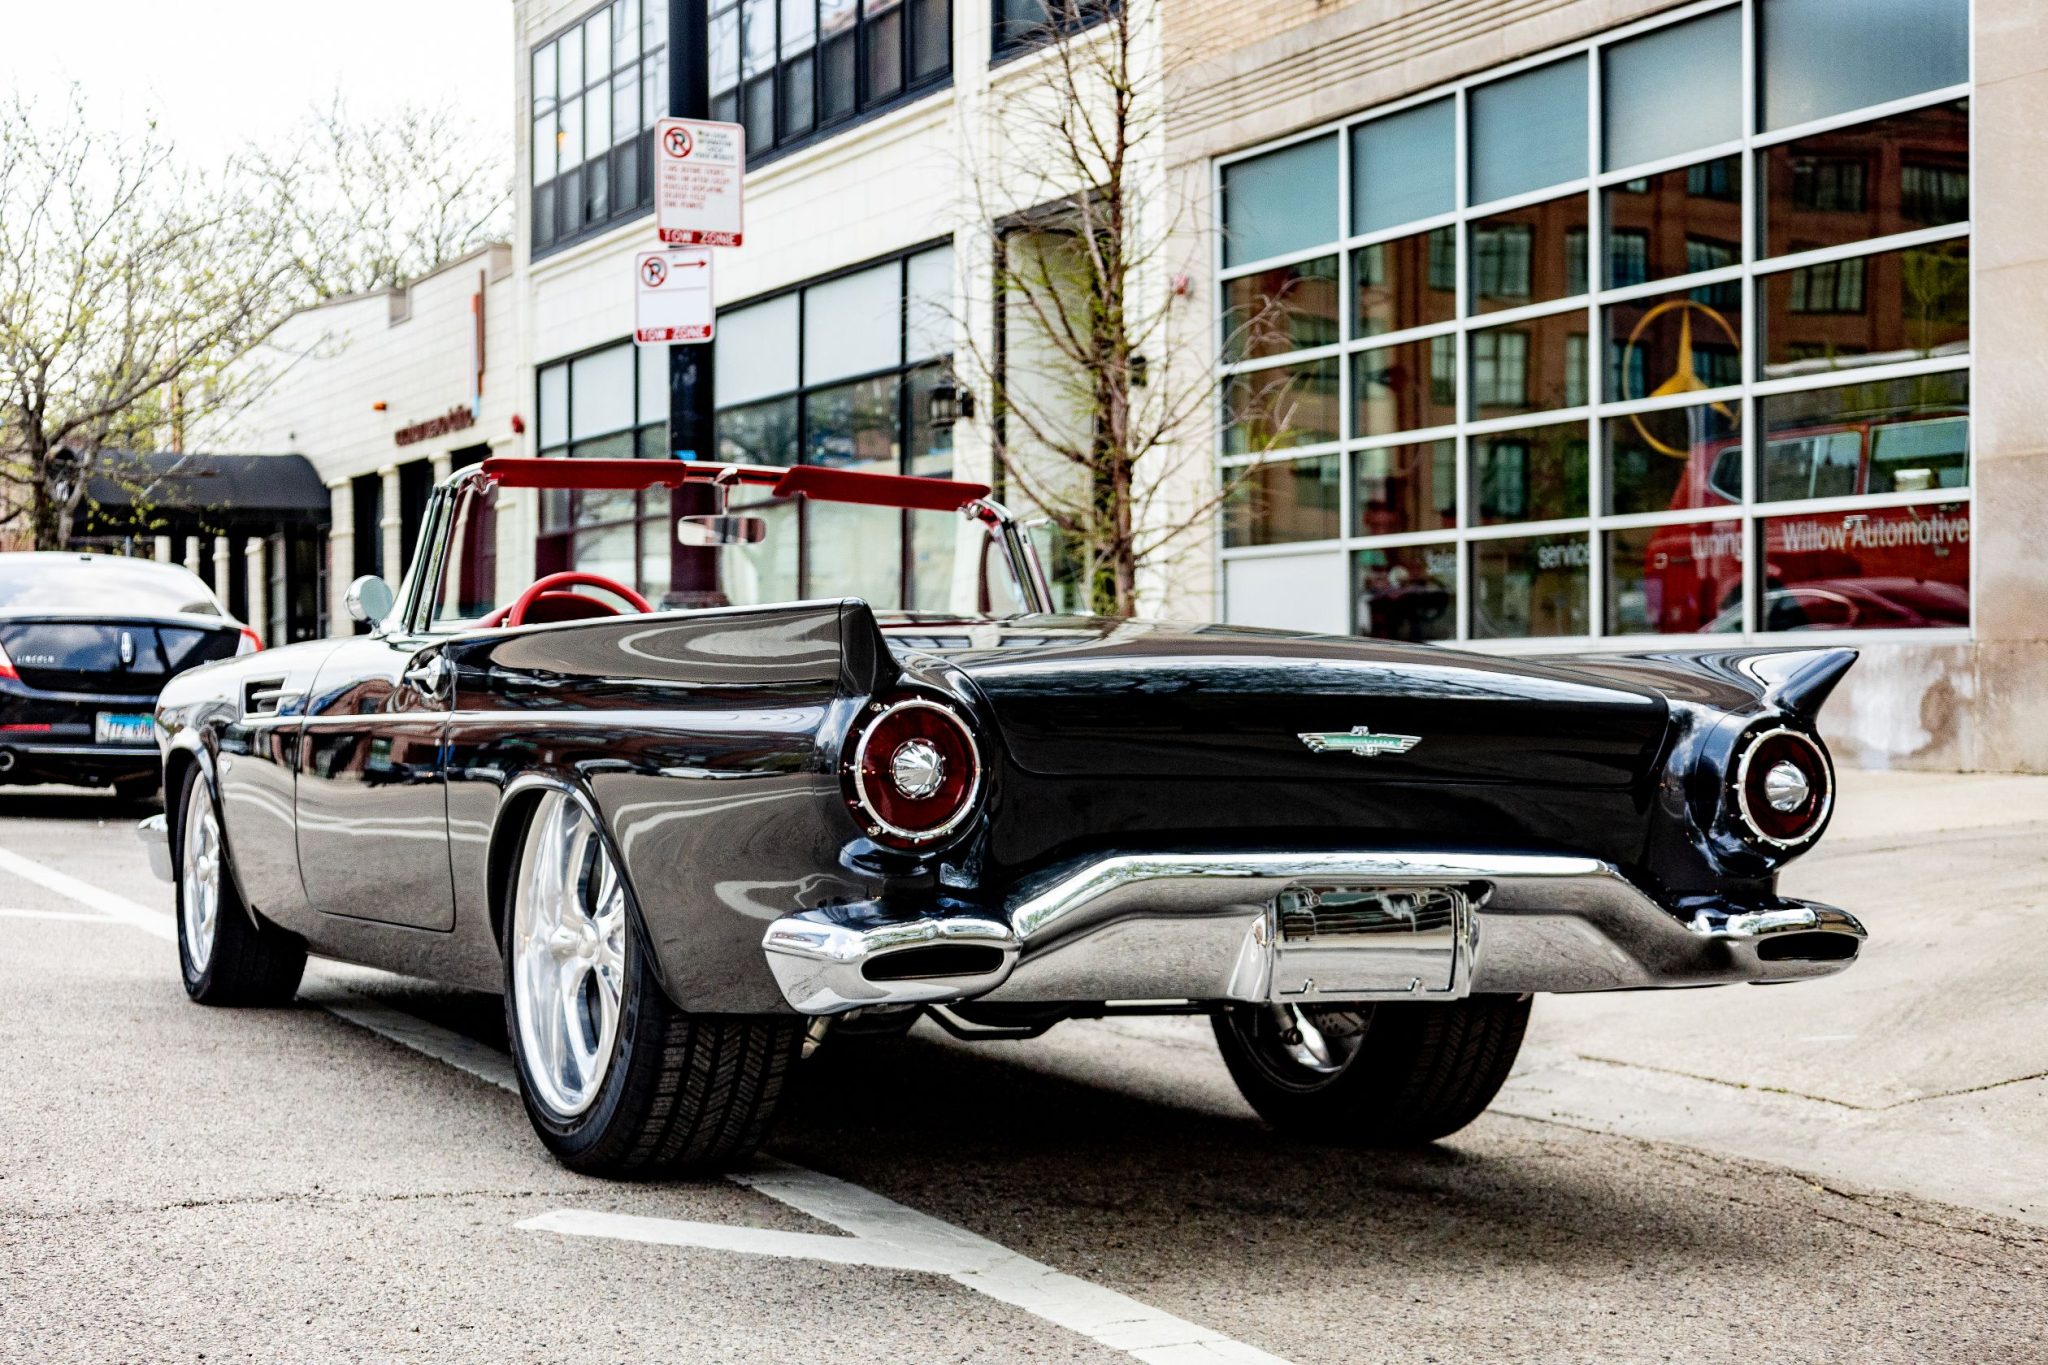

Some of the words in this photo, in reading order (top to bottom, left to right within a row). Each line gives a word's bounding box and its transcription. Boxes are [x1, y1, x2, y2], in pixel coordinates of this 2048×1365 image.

[664, 230, 693, 243] TOW
[700, 232, 737, 245] ZONE
[641, 328, 667, 341] TOW
[672, 326, 705, 339] ZONE
[1782, 520, 1846, 551] Willow
[1853, 515, 1969, 548] Automotive
